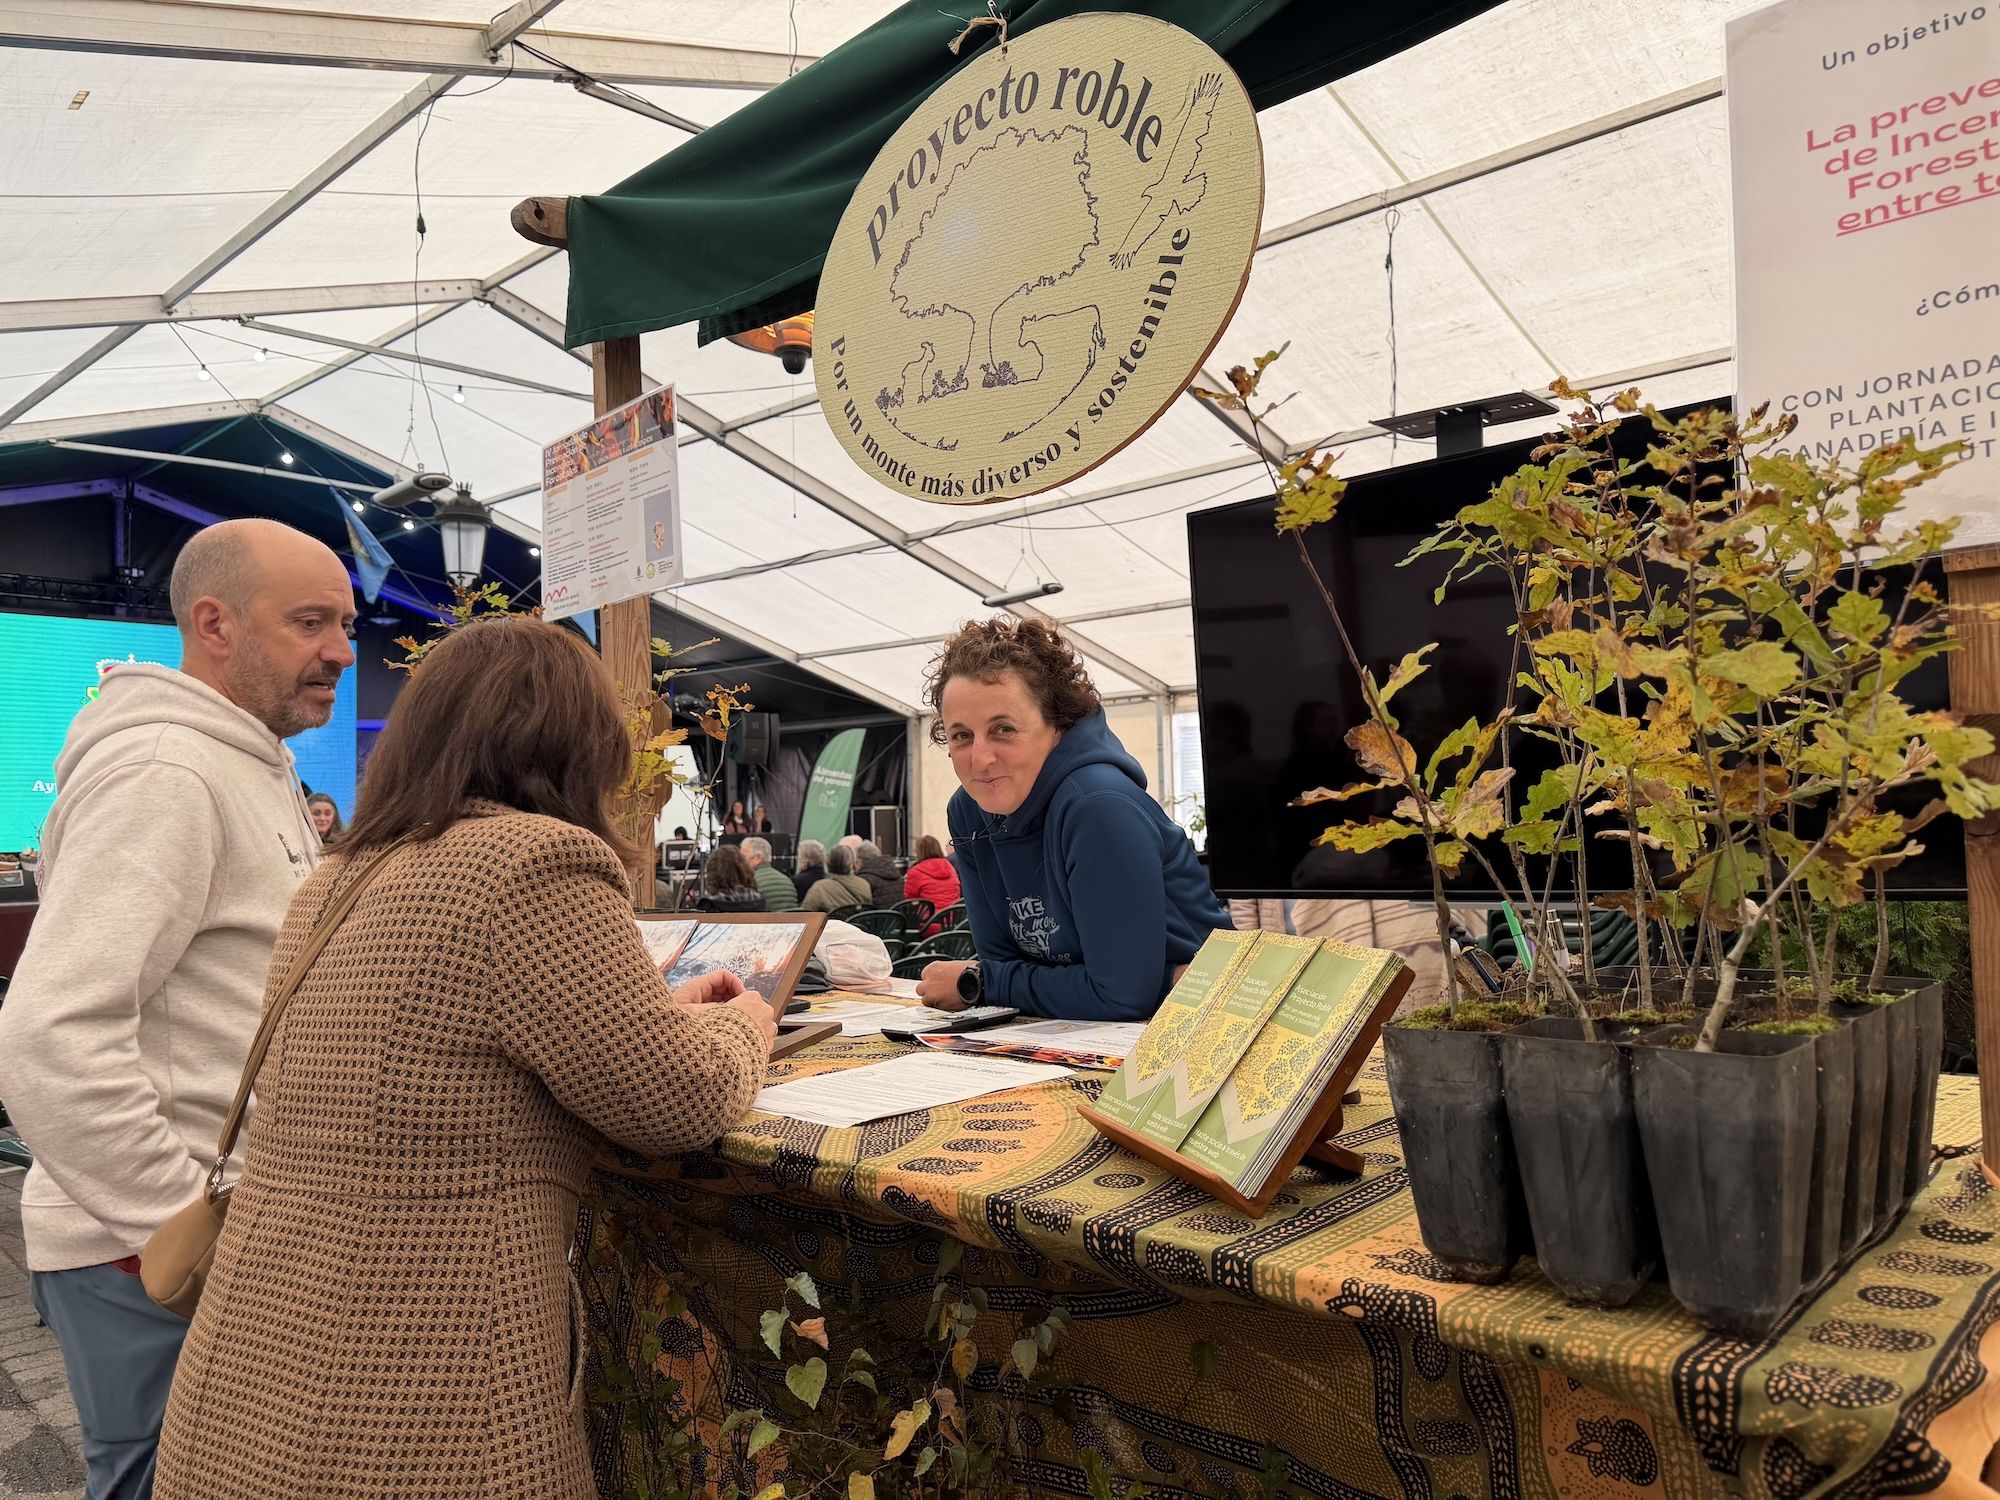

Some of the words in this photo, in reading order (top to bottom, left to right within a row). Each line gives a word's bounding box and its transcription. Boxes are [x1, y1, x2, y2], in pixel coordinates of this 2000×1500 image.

[1821, 49, 1856, 72] Un
[1866, 5, 1987, 57] objetivo
[1806, 124, 1857, 153] La
[1870, 78, 2000, 139] preve
[865, 64, 1040, 269] proyecto
[1049, 58, 1163, 163] roble
[1824, 147, 1878, 176] de
[1847, 138, 2000, 200] Forest
[1837, 185, 1962, 231] entre
[1915, 283, 2000, 317] ¿Cóm
[831, 333, 849, 393] Por
[844, 400, 862, 435] un
[862, 431, 917, 487] monte
[921, 472, 965, 498] más
[972, 441, 1062, 494] diverso
[1071, 422, 1082, 452] y
[1087, 227, 1191, 425] sostenible
[1781, 385, 1844, 413] CON
[1855, 354, 2000, 399] JORNADA
[1961, 413, 1976, 434] E
[32, 780, 56, 794] Ay
[1289, 992, 1318, 1009] Proyecto
[1294, 984, 1328, 1001] Asociación
